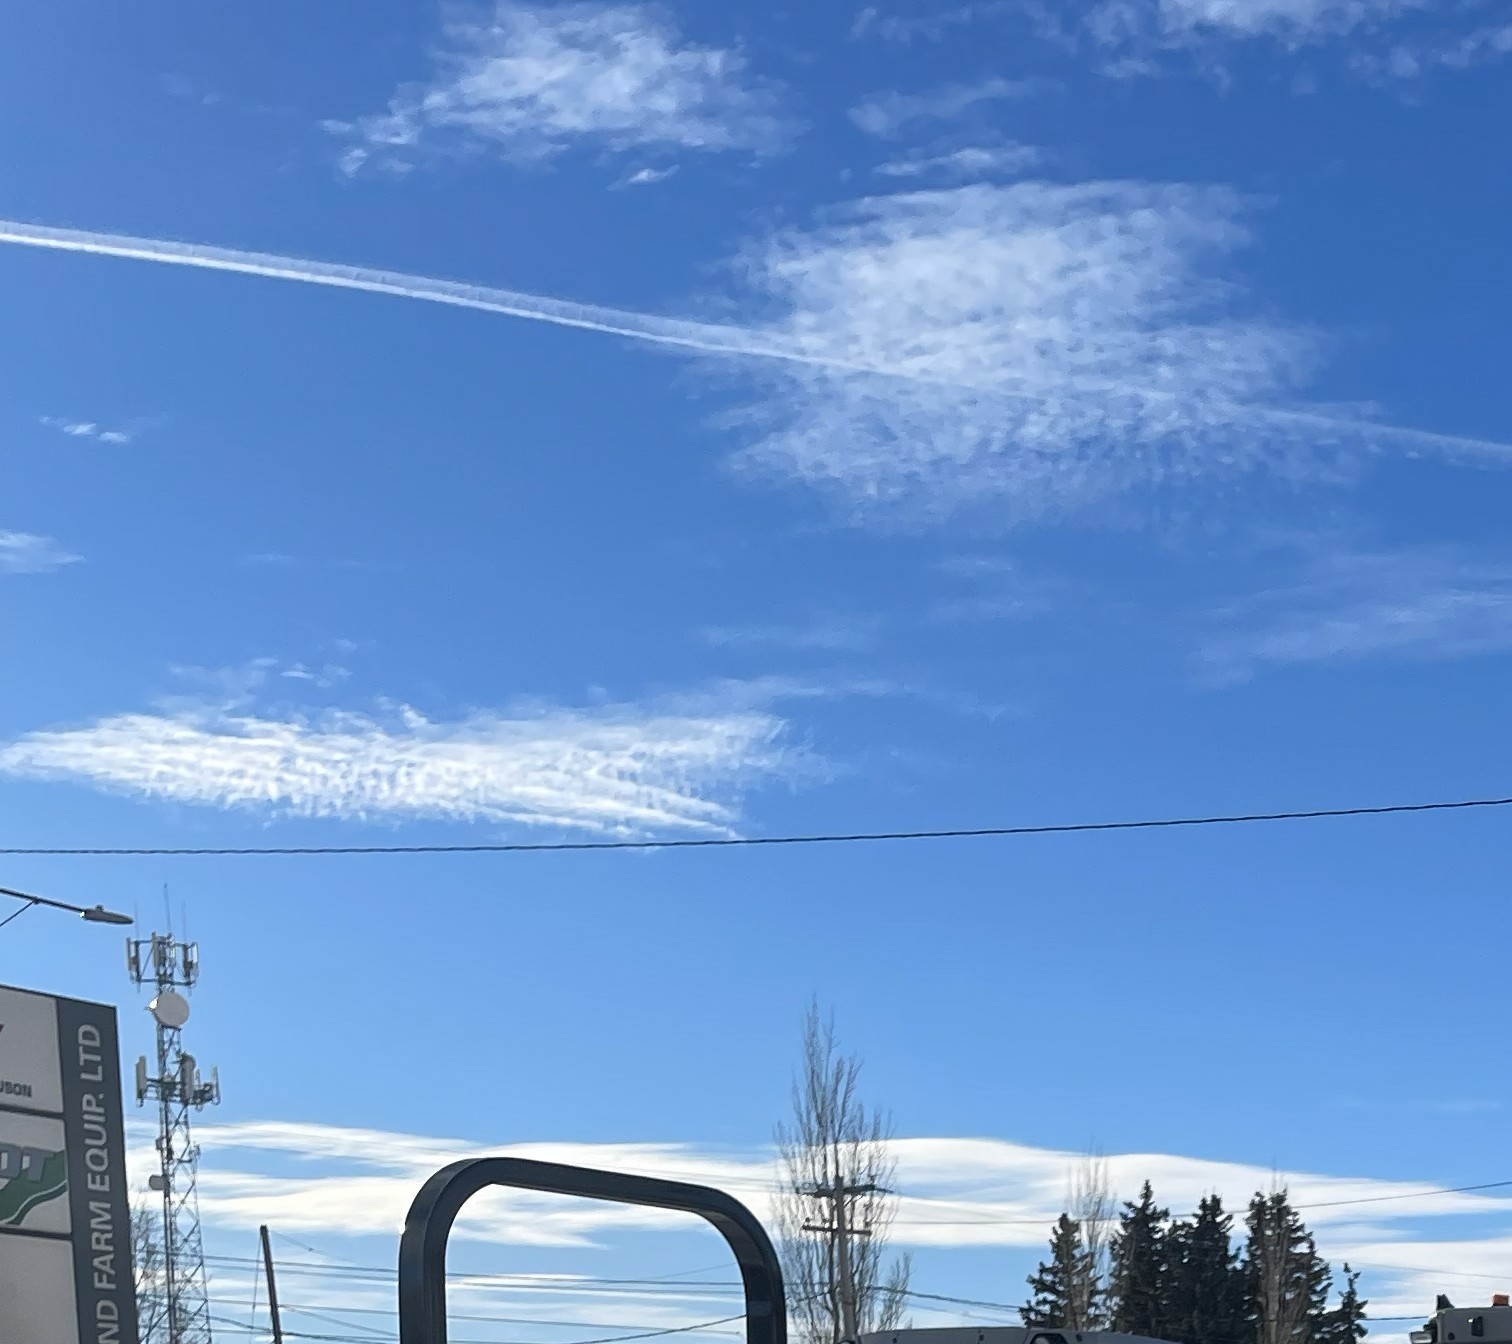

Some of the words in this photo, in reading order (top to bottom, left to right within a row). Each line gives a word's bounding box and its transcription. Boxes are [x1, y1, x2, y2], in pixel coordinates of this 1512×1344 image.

[77, 1023, 104, 1082] LTD
[81, 1092, 111, 1193] EQUIP.
[89, 1201, 118, 1290] FARM
